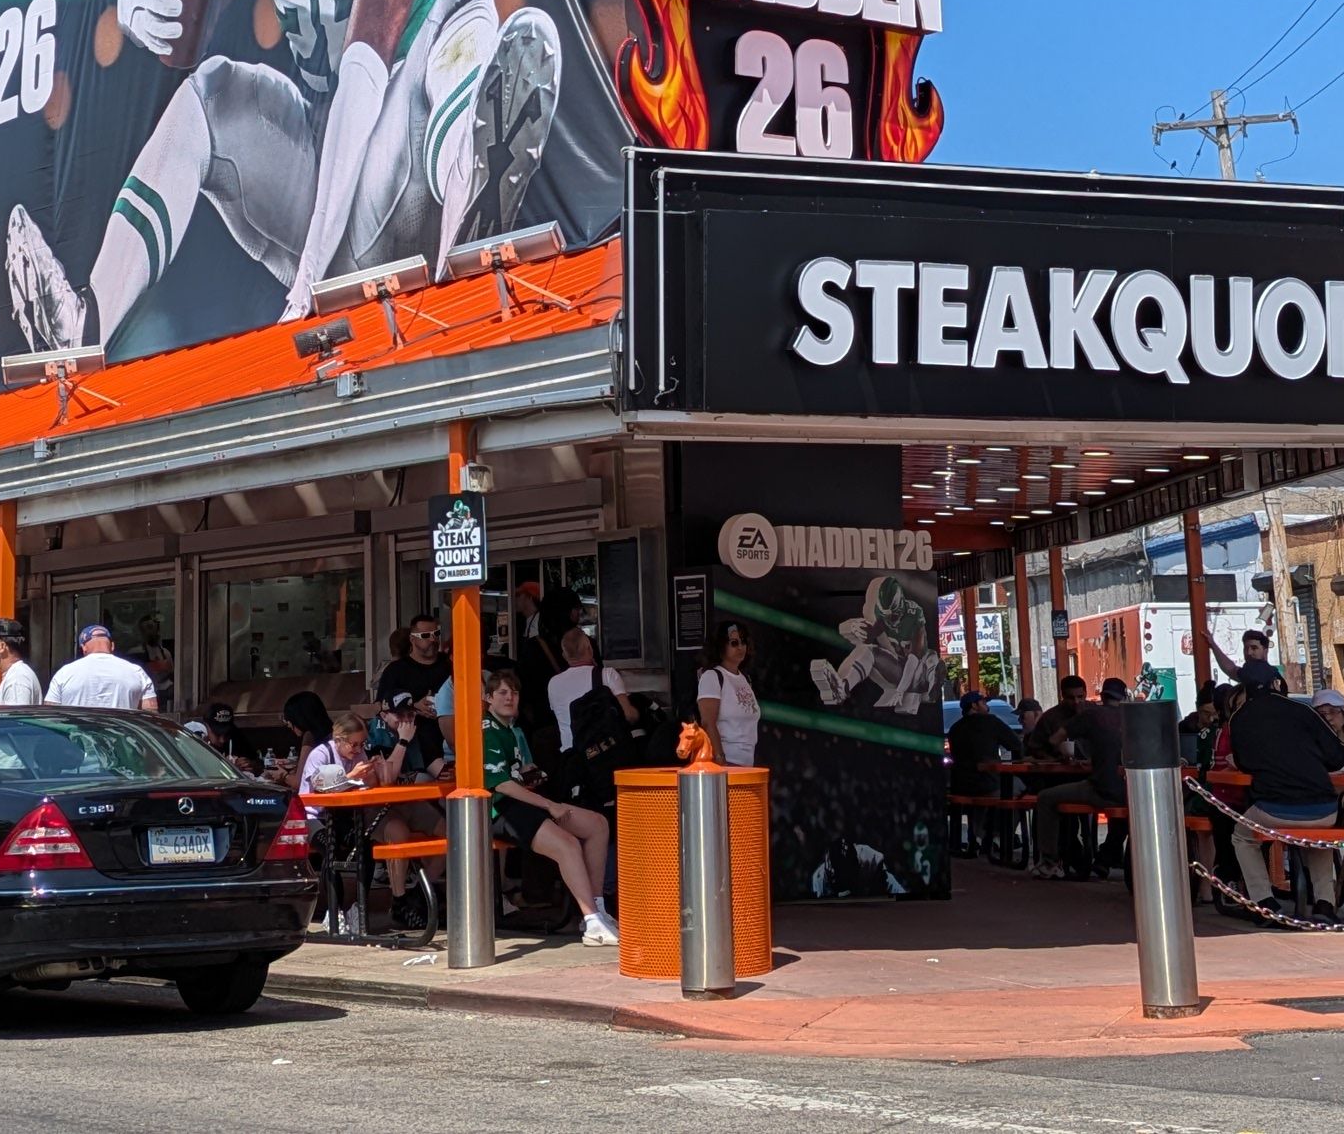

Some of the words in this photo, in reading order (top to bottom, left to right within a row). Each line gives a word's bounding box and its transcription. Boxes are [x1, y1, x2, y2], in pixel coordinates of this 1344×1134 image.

[734, 30, 853, 158] 26
[437, 531, 476, 547] STEAK-
[737, 527, 768, 549] EA
[435, 548, 480, 566] QUON'S
[736, 549, 770, 561] SPORTS
[778, 526, 896, 569] MADDEN
[898, 530, 934, 571] 26
